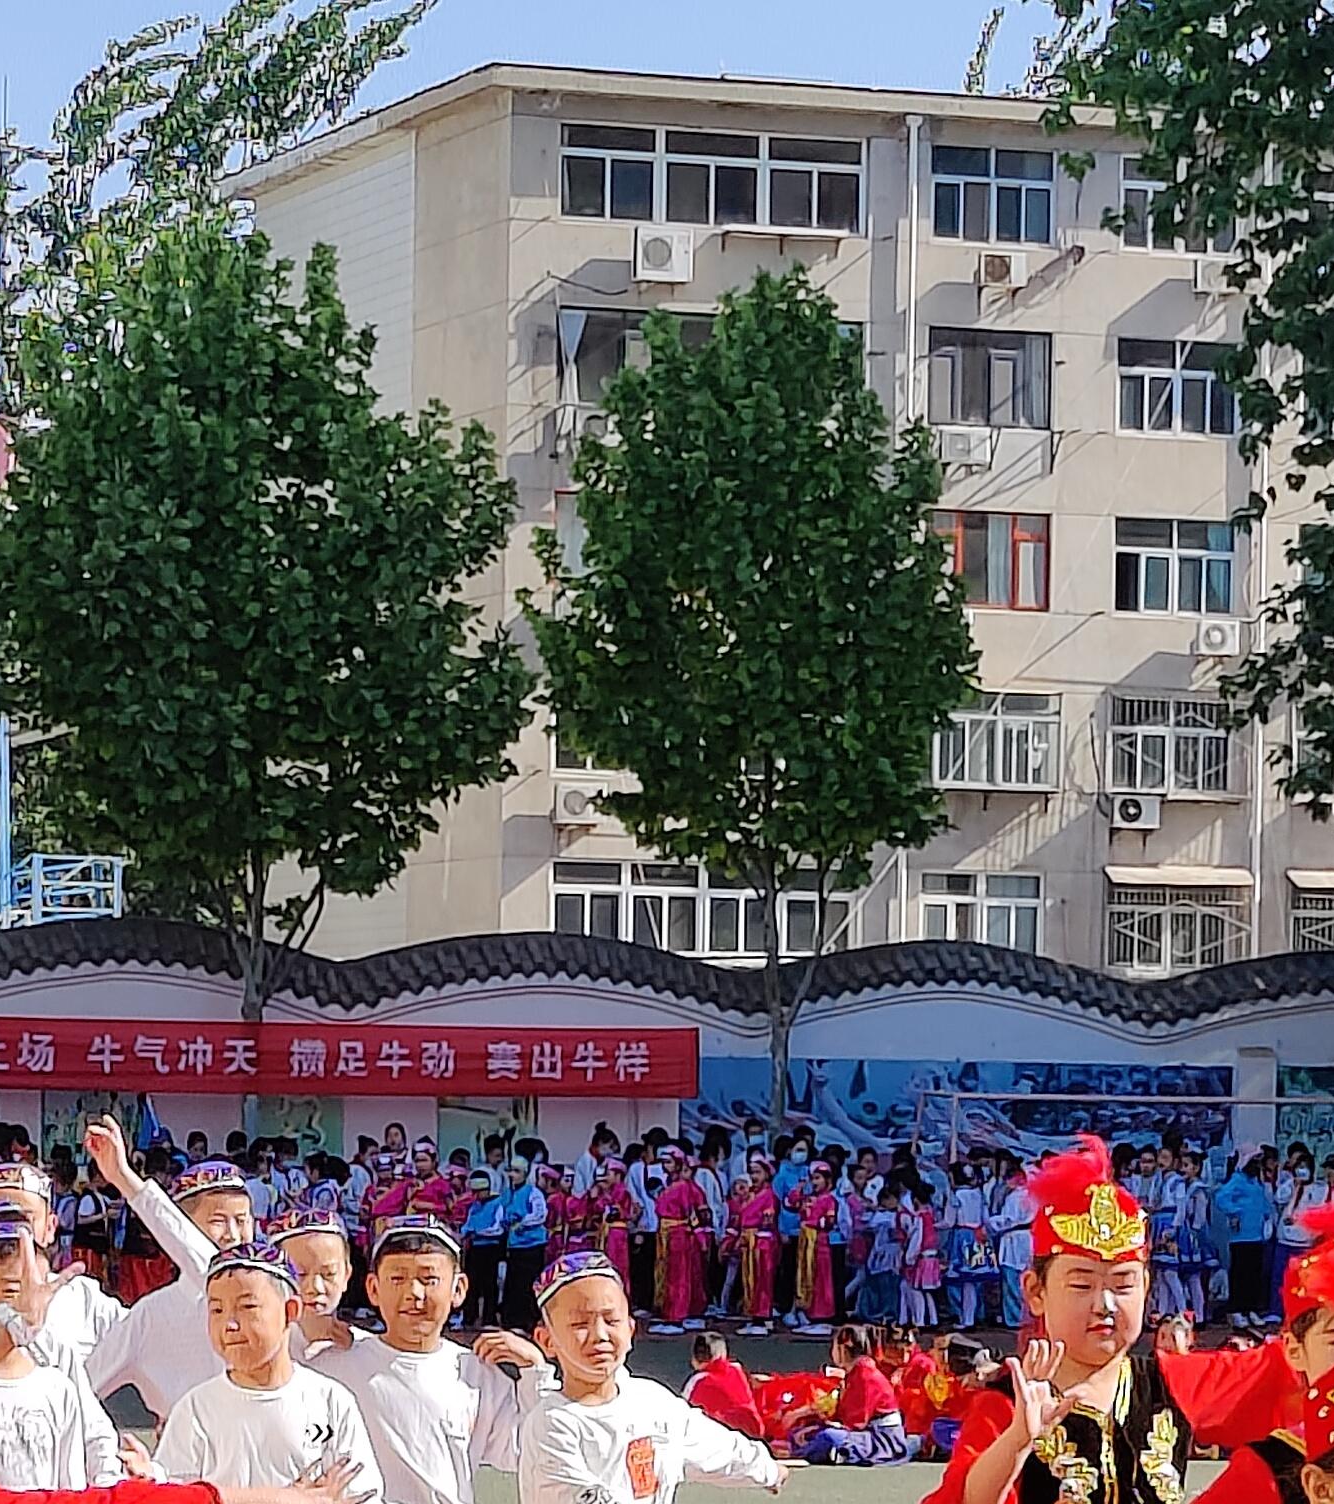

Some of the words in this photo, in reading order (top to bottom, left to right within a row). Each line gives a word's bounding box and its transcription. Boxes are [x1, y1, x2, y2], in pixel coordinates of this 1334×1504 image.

[87, 1035, 259, 1075] 牛气冲天
[486, 1040, 650, 1082] 赛出牛样
